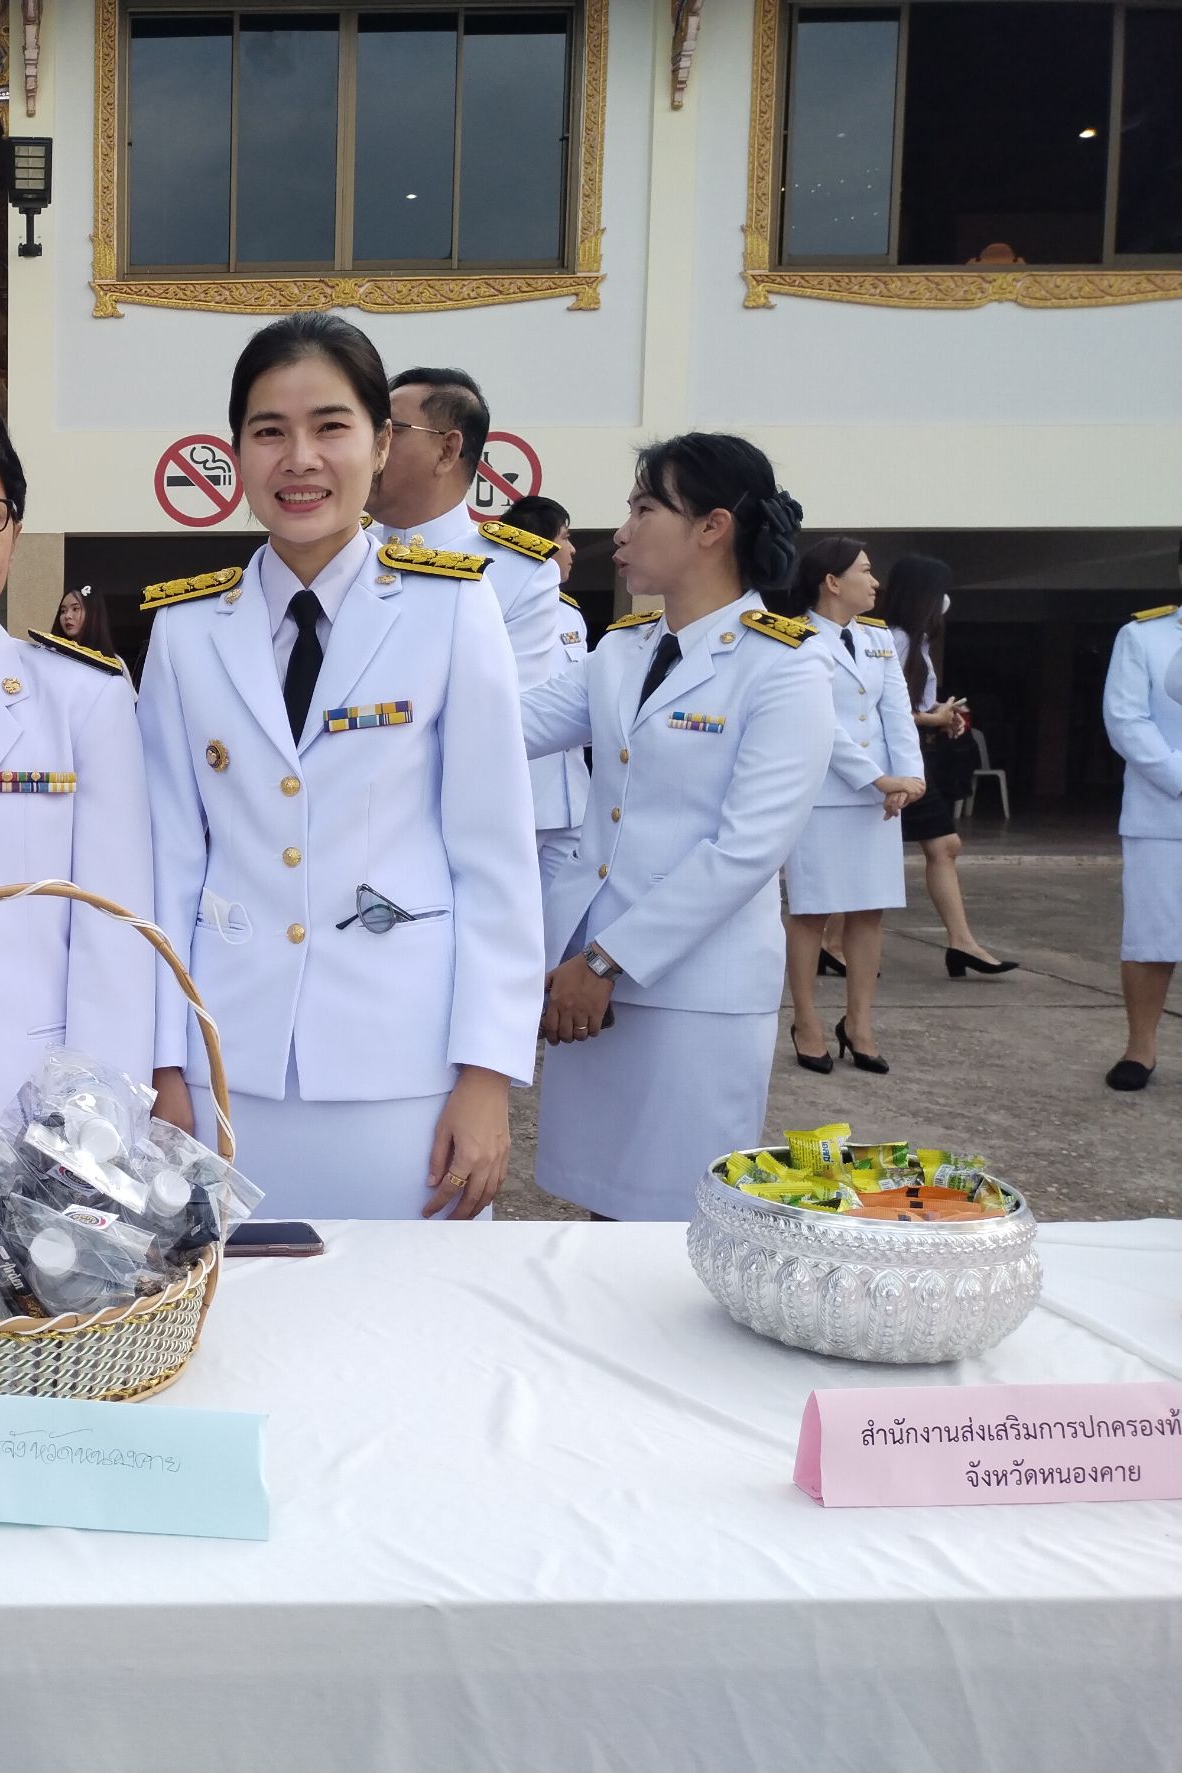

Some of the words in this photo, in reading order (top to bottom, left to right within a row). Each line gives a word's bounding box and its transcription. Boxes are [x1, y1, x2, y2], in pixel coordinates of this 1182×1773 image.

[964, 1458, 1142, 1488] จังหวัดหนองคาย
